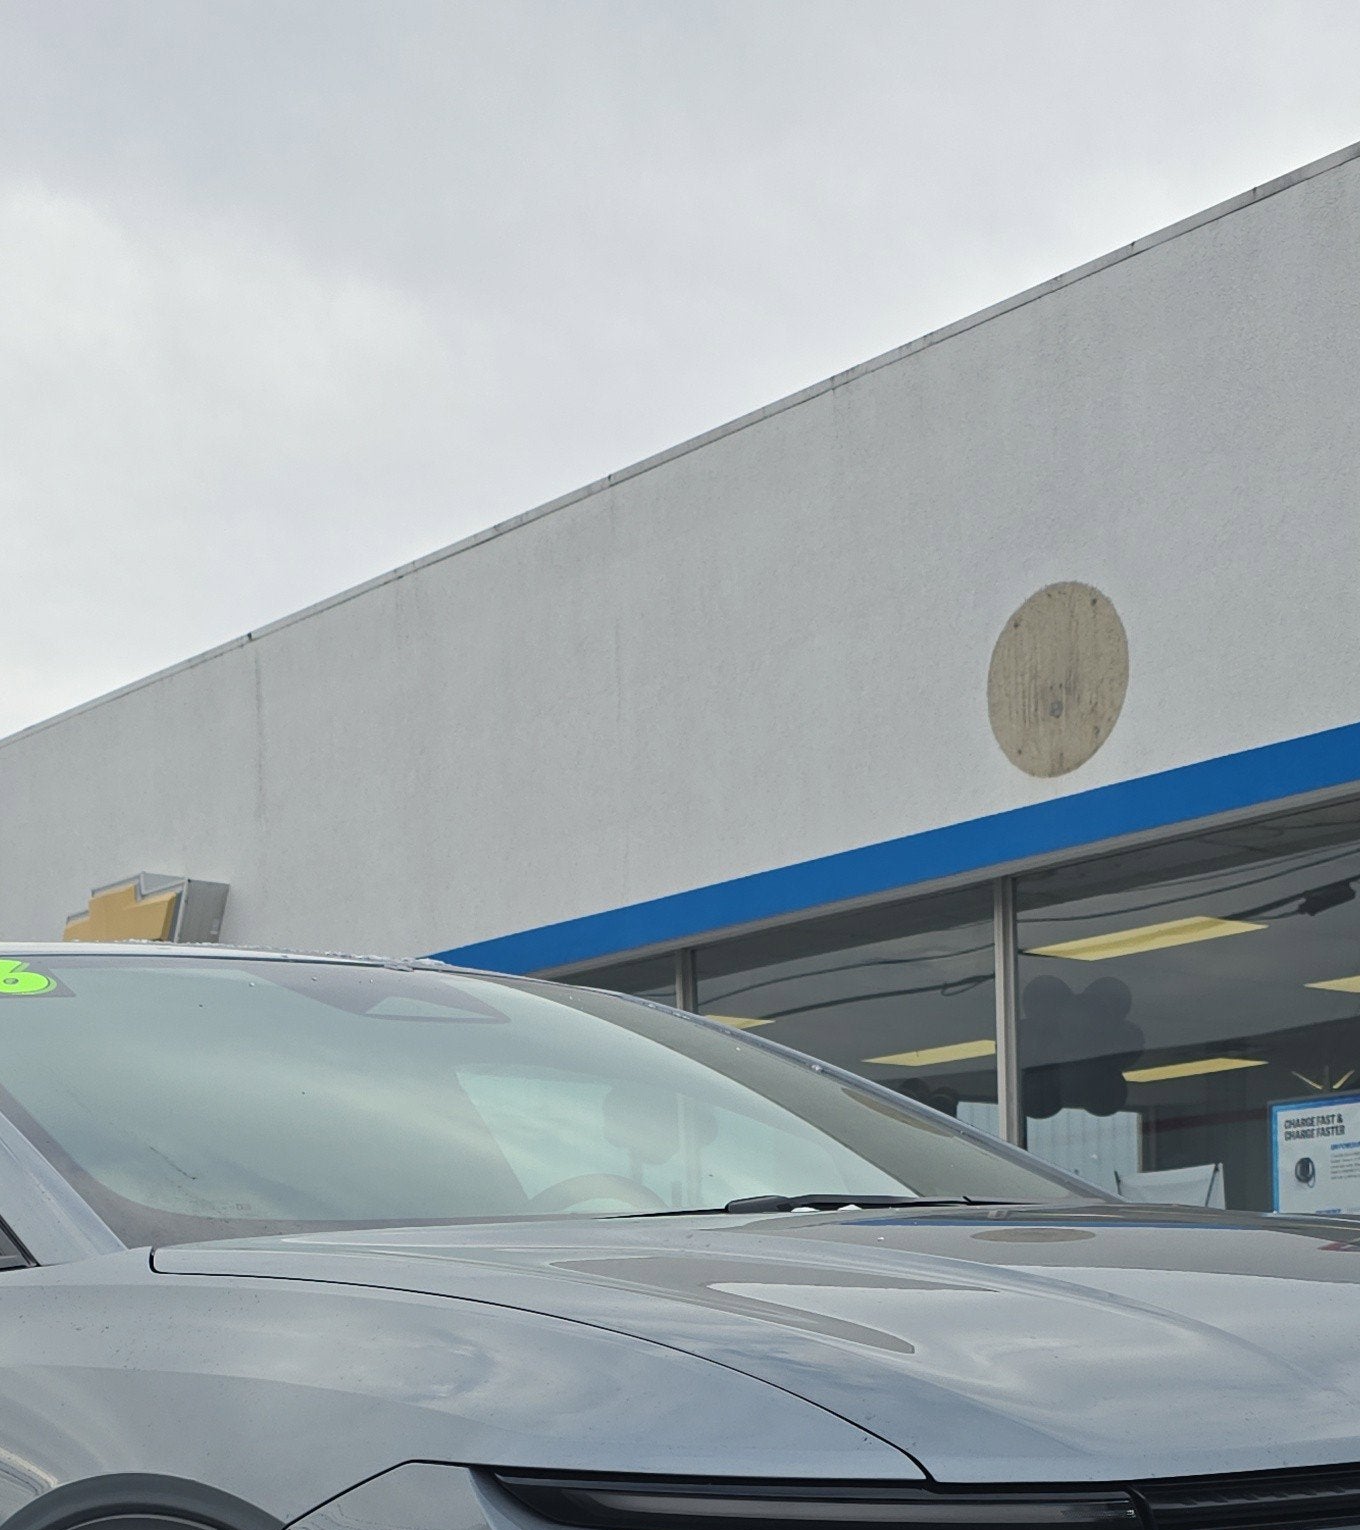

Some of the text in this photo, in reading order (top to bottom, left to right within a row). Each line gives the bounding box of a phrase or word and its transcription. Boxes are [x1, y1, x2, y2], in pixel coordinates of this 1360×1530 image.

[1316, 1114, 1336, 1126] FAST
[1336, 1113, 1344, 1124] &
[1316, 1125, 1346, 1138] FASTER
